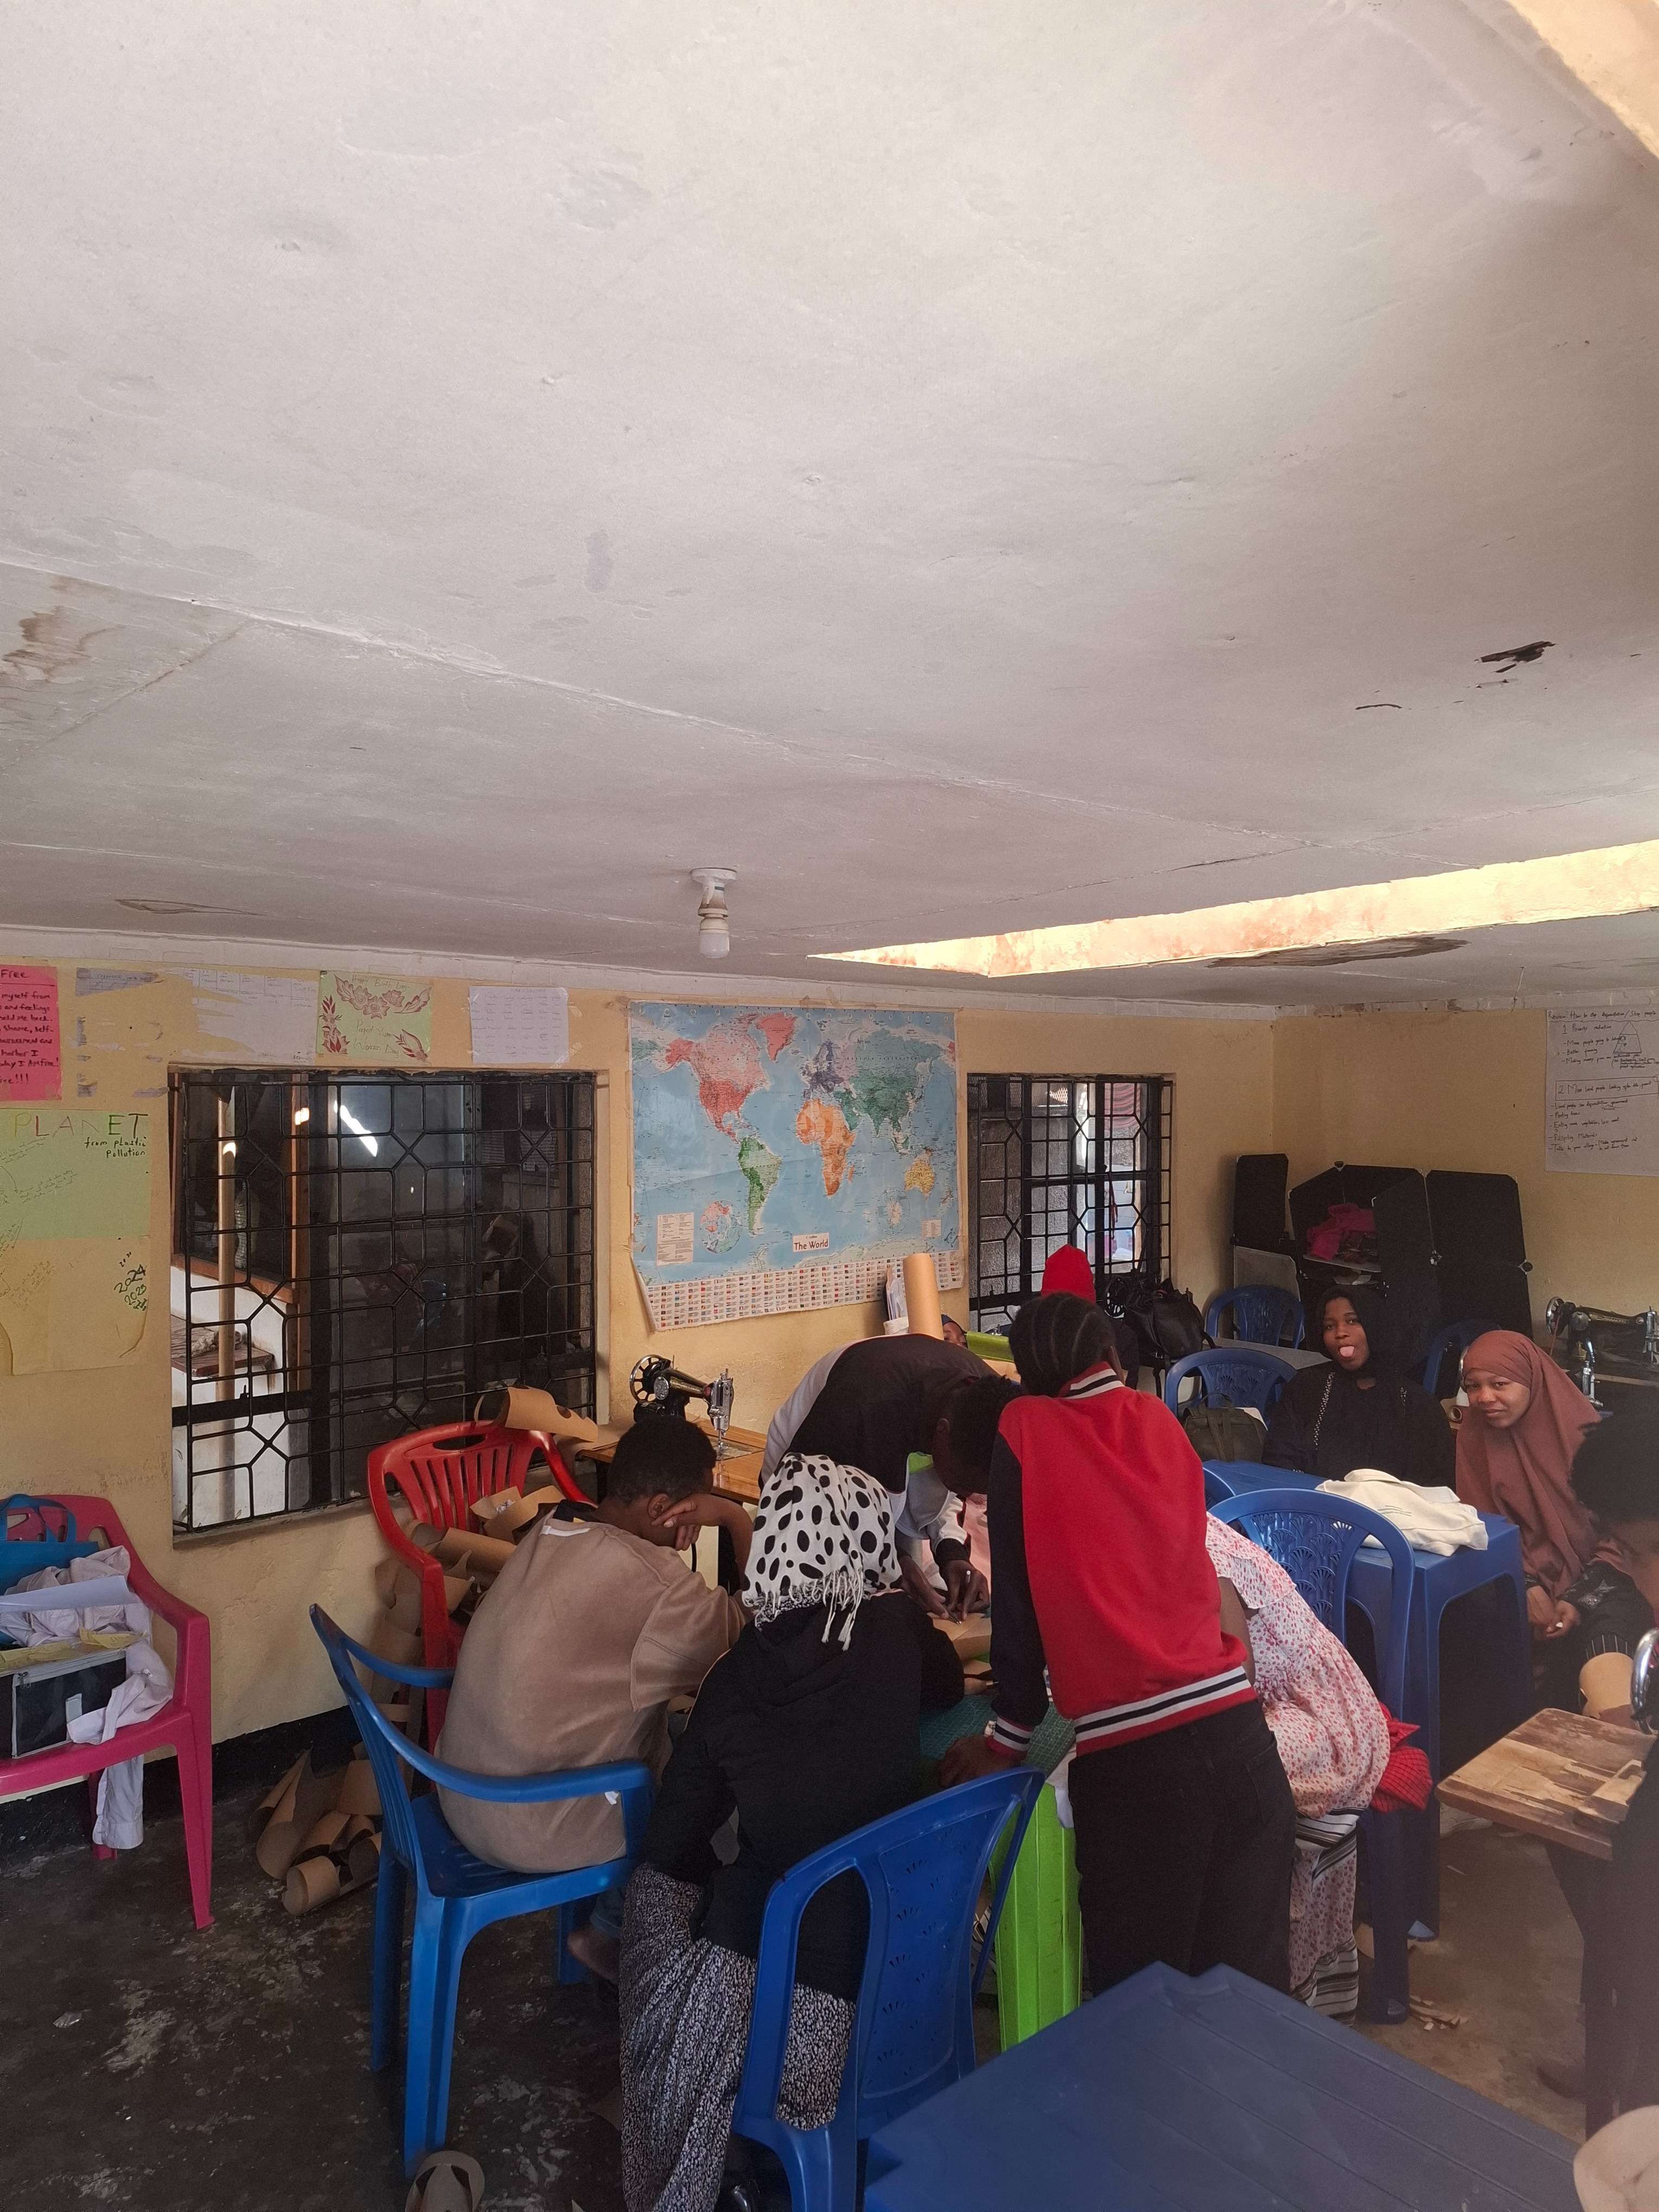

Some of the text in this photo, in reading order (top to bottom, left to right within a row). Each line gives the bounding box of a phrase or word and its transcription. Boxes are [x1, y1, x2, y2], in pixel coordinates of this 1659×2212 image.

[1, 969, 30, 978] Free
[1, 991, 51, 1001] myself from
[19, 1003, 50, 1014] feelings
[84, 1136, 108, 1149] from
[794, 1238, 828, 1250] The World
